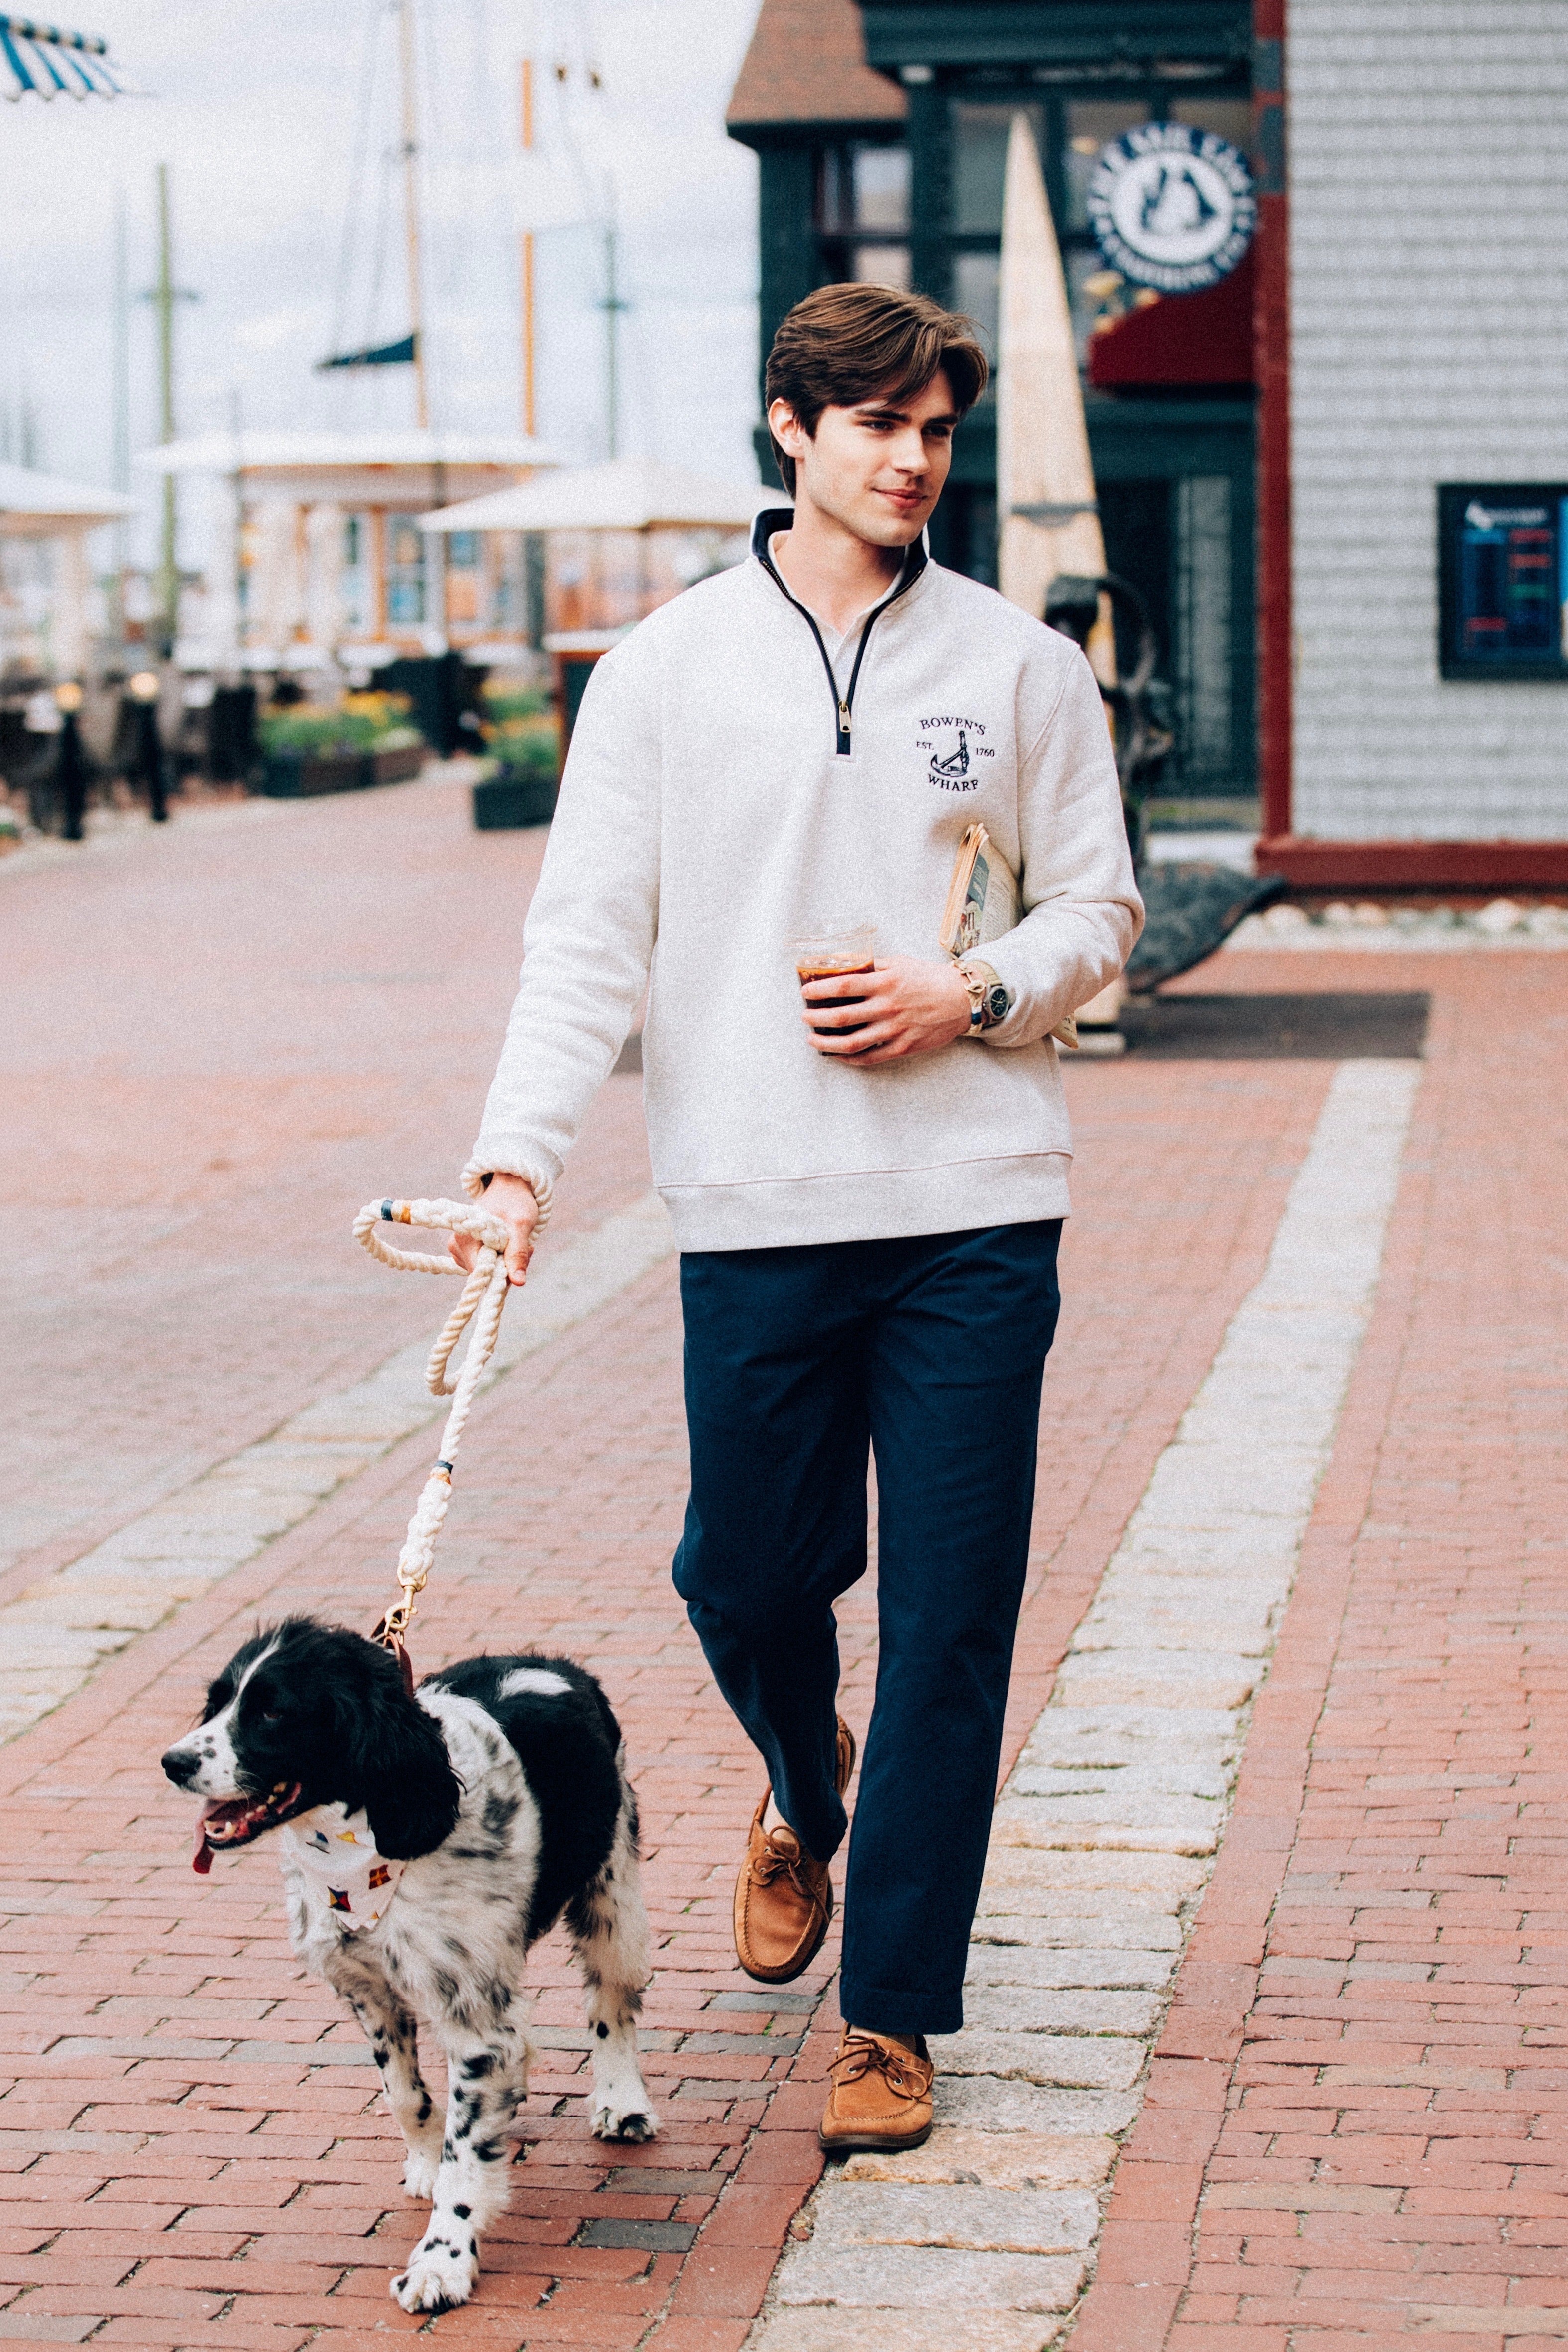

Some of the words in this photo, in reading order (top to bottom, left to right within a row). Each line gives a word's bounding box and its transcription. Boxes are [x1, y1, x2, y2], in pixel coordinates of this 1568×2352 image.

[919, 717, 986, 735] BOWEN'S
[916, 741, 934, 750] EST.
[976, 747, 995, 757] 1760
[927, 773, 979, 792] WHARF
